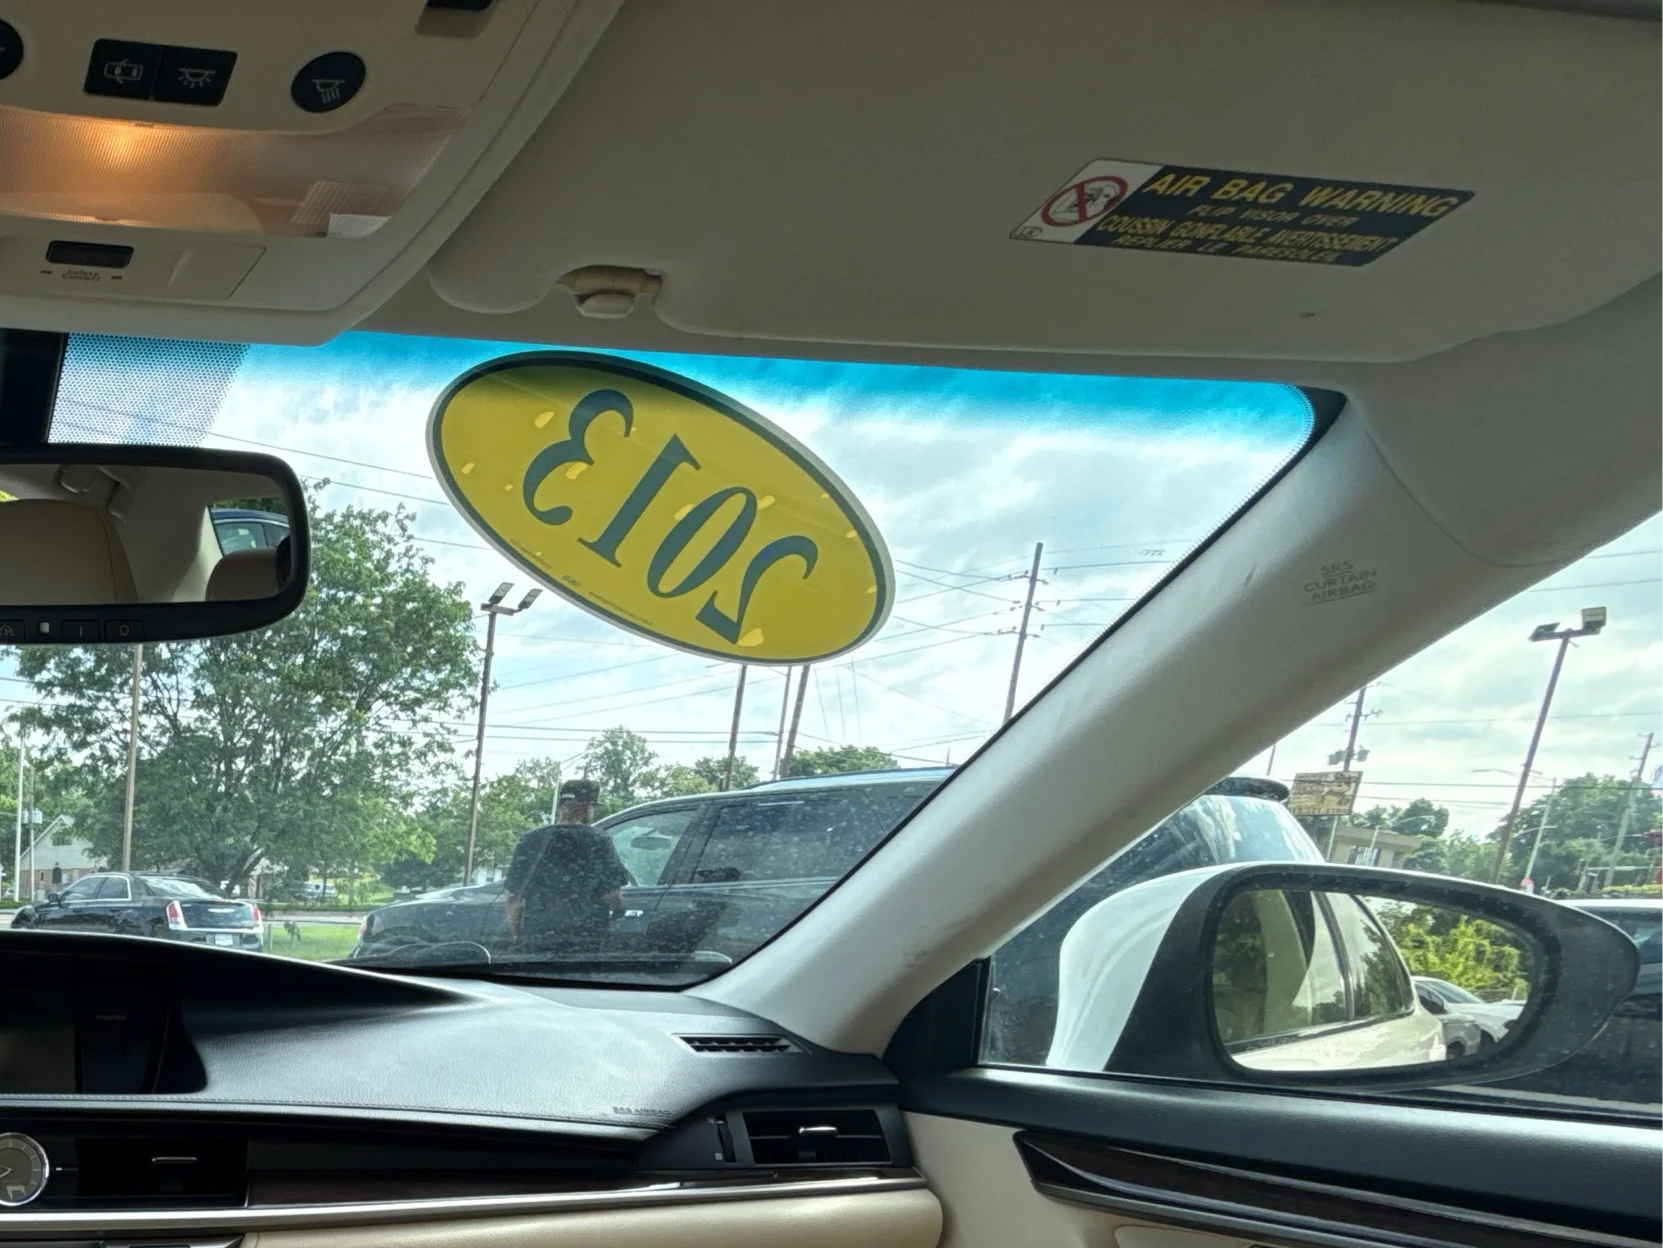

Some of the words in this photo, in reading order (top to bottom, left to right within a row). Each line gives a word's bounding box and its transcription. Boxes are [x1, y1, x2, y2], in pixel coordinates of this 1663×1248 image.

[1142, 173, 1211, 197] AIR
[1211, 178, 1294, 204] BAG
[1299, 185, 1458, 217] WARNING
[1187, 204, 1237, 217] FLIP
[1239, 208, 1300, 223] VISOR
[1301, 214, 1360, 228] OVER
[1096, 214, 1175, 235] COUSSIN
[1170, 220, 1272, 244] GONFLABLE
[1263, 229, 1400, 252] AVERTISSEMENT
[1303, 568, 1377, 592] CURTAIN
[1321, 561, 1354, 576] SRS
[1311, 580, 1376, 601] AIRBAG
